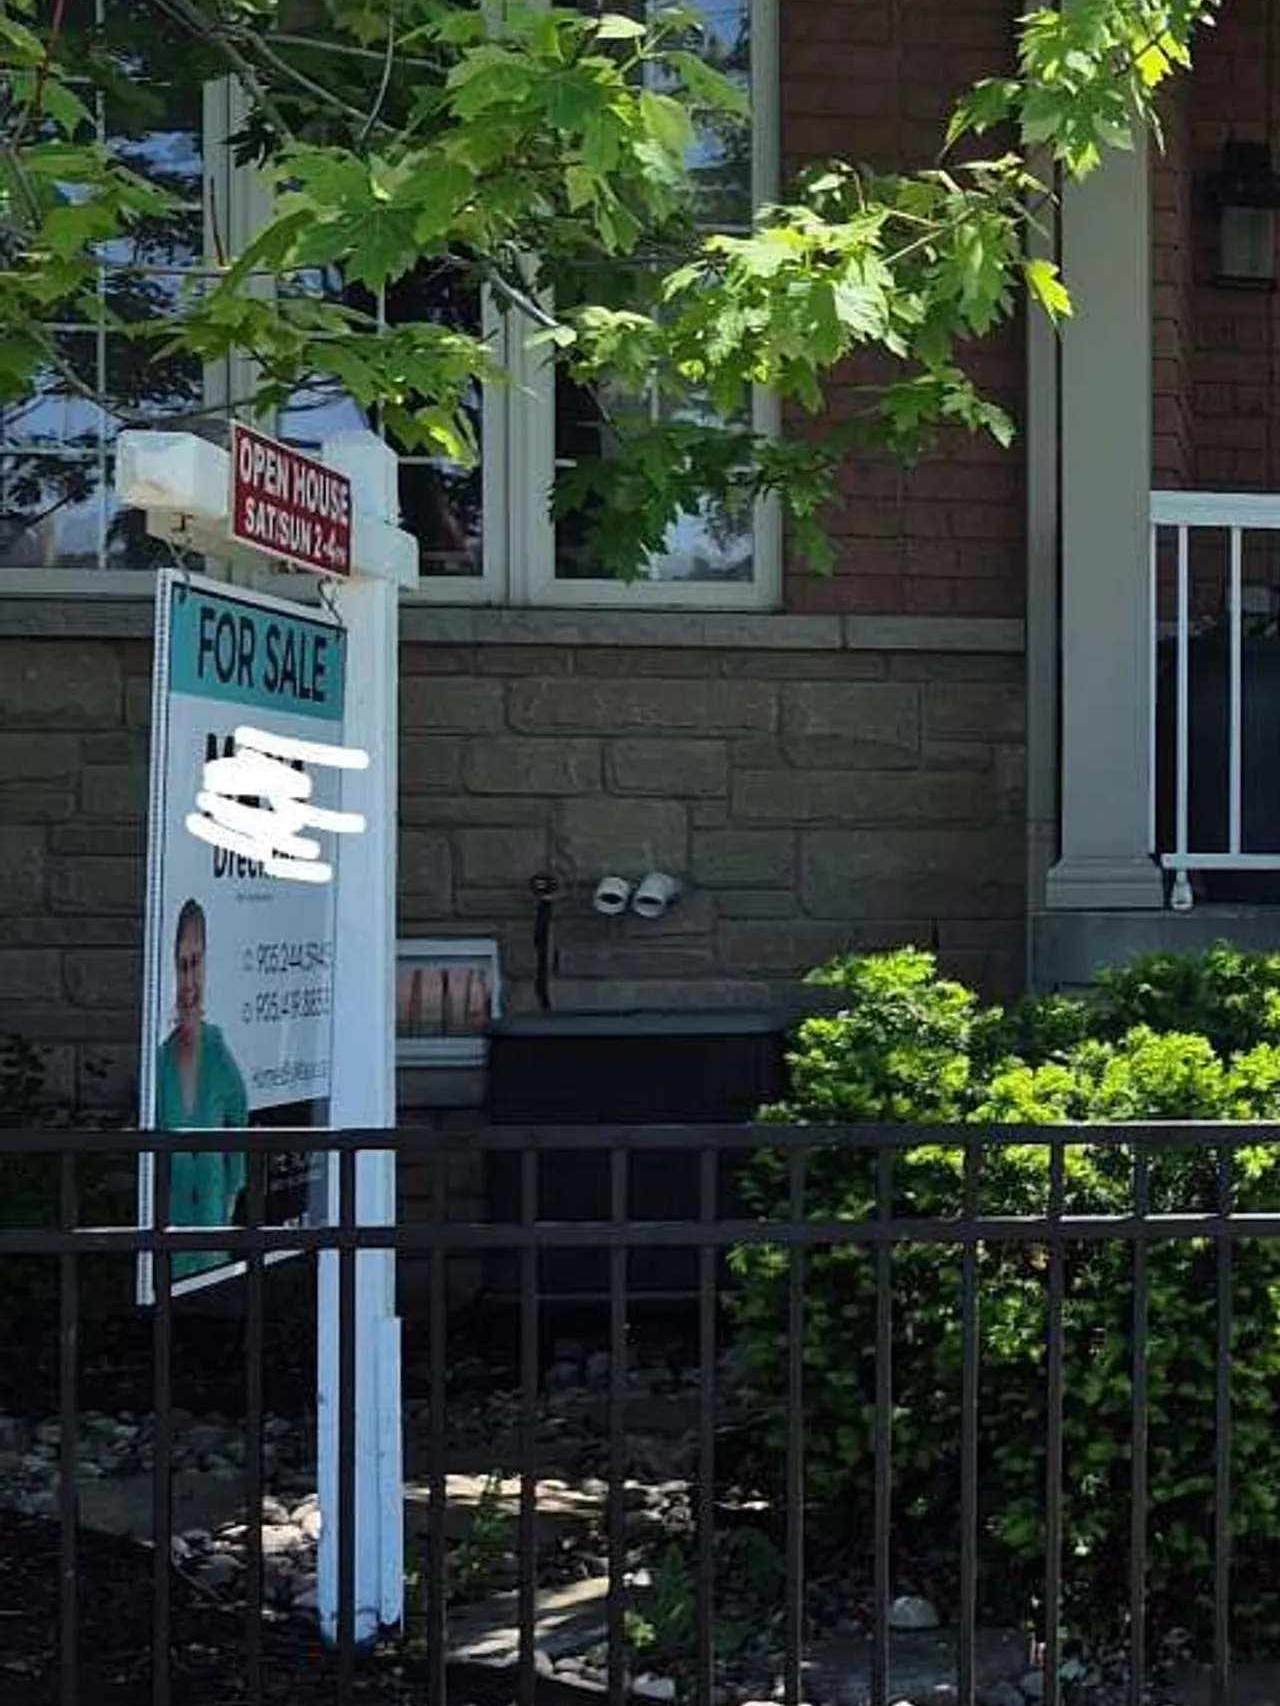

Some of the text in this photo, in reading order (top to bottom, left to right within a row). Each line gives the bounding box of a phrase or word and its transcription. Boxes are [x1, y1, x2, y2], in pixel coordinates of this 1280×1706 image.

[240, 437, 348, 526] OPEN HOUSE
[198, 607, 327, 702] FOR SALE
